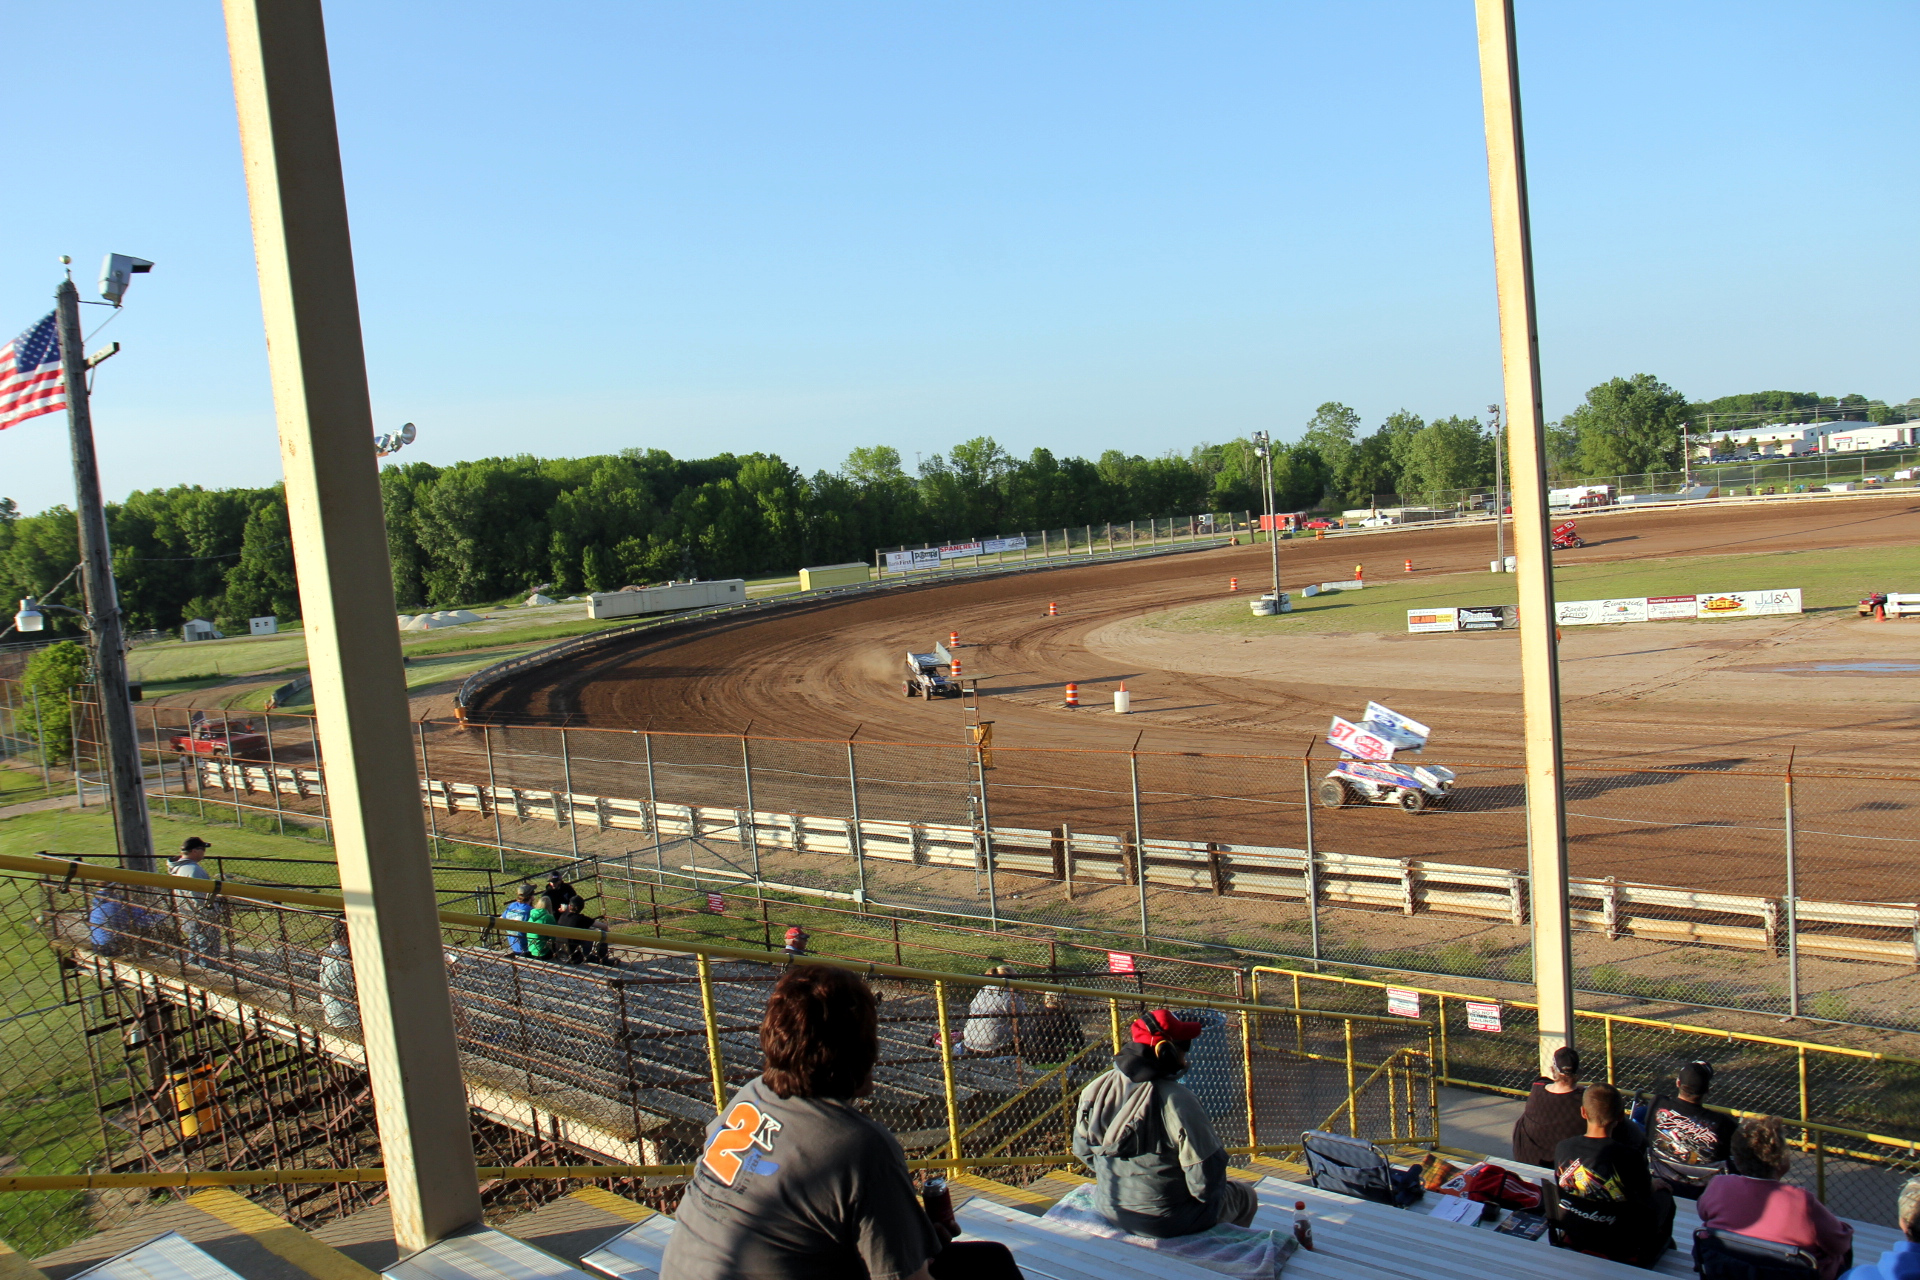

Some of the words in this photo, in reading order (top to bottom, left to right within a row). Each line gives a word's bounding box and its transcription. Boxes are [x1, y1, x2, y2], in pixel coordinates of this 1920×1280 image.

[940, 542, 981, 552] SPANCRETE
[1603, 601, 1644, 609] Riverside
[1331, 722, 1356, 741] 57
[1558, 1198, 1617, 1225] Smokey
